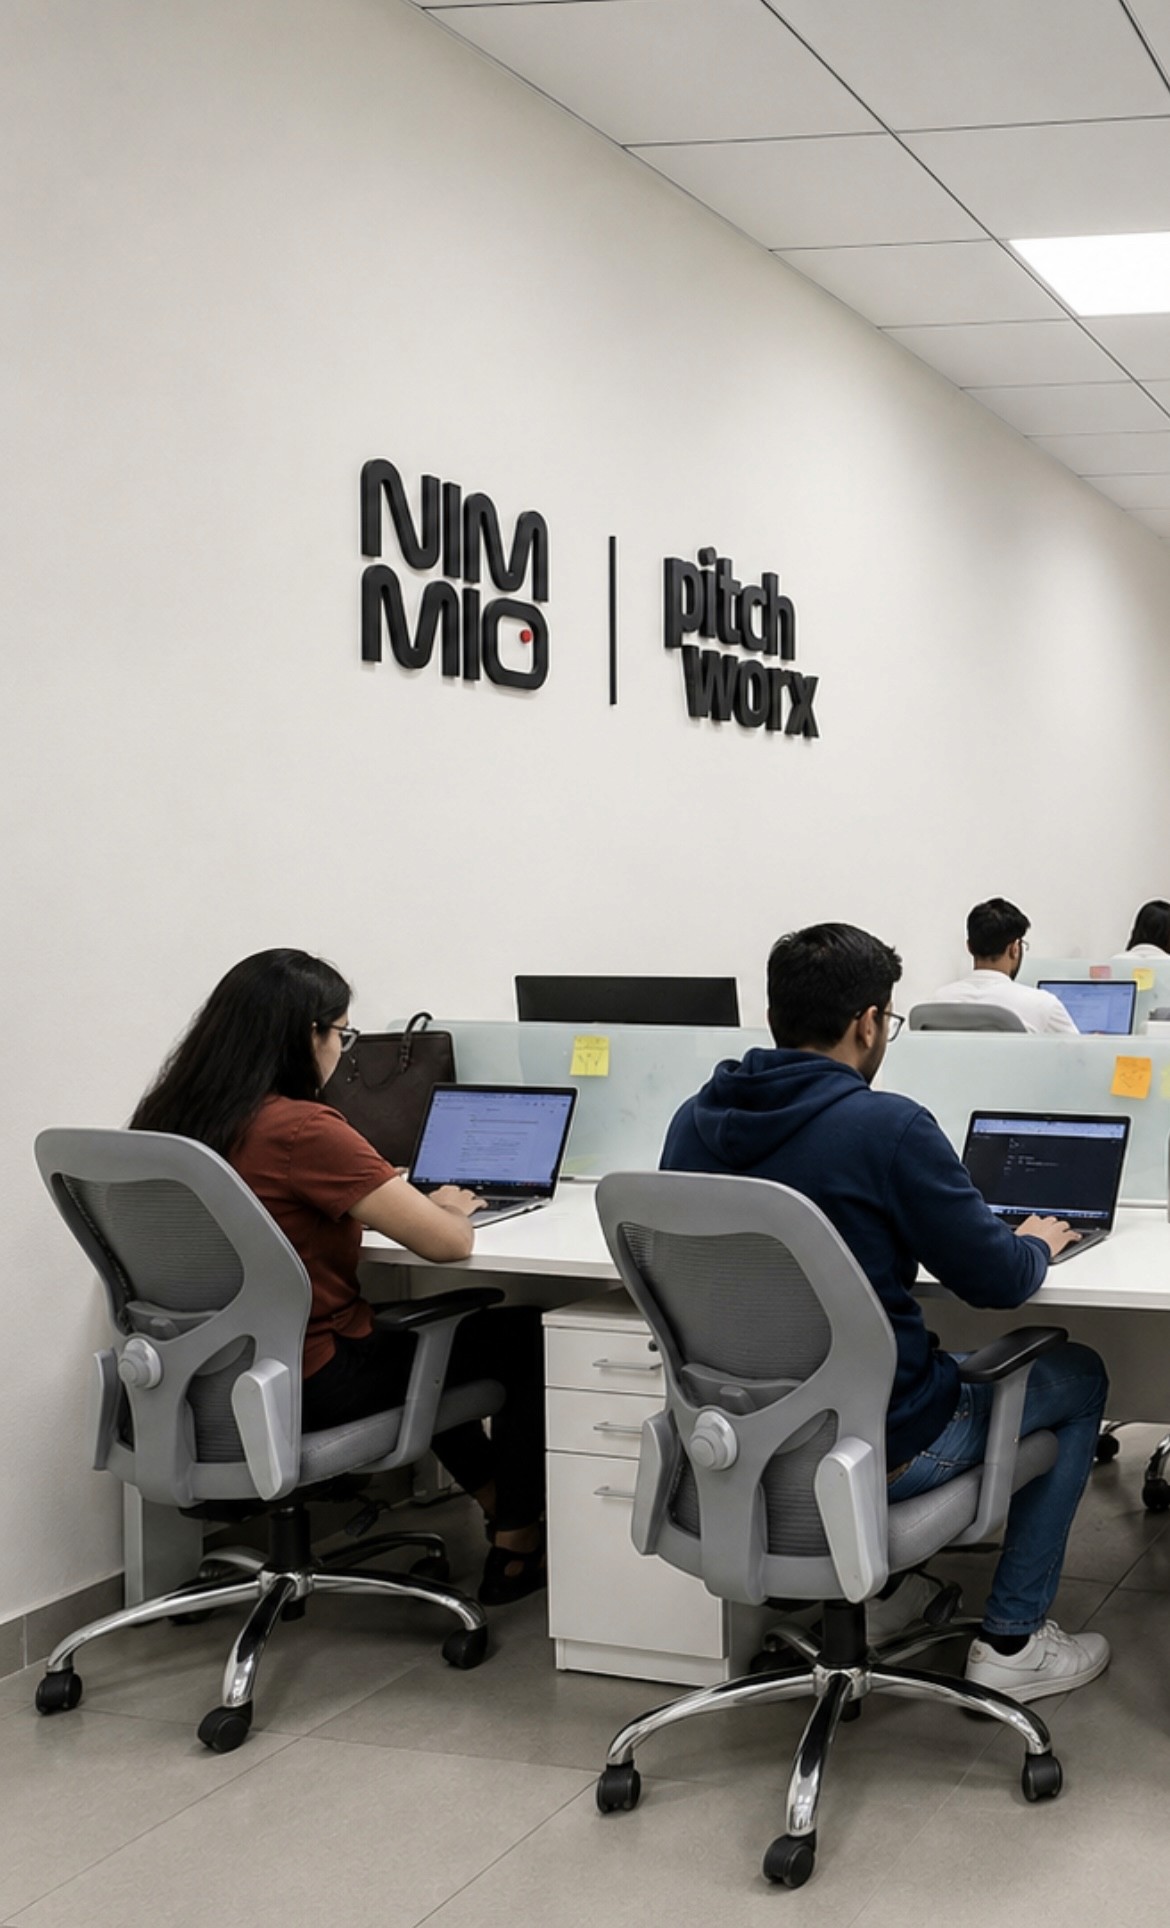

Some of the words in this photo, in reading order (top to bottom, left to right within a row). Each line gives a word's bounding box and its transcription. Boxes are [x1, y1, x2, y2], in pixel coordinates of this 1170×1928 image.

[360, 458, 549, 603] NIM
[360, 564, 549, 691] MIO
[663, 546, 796, 661] pitch
[680, 644, 820, 739] worx
